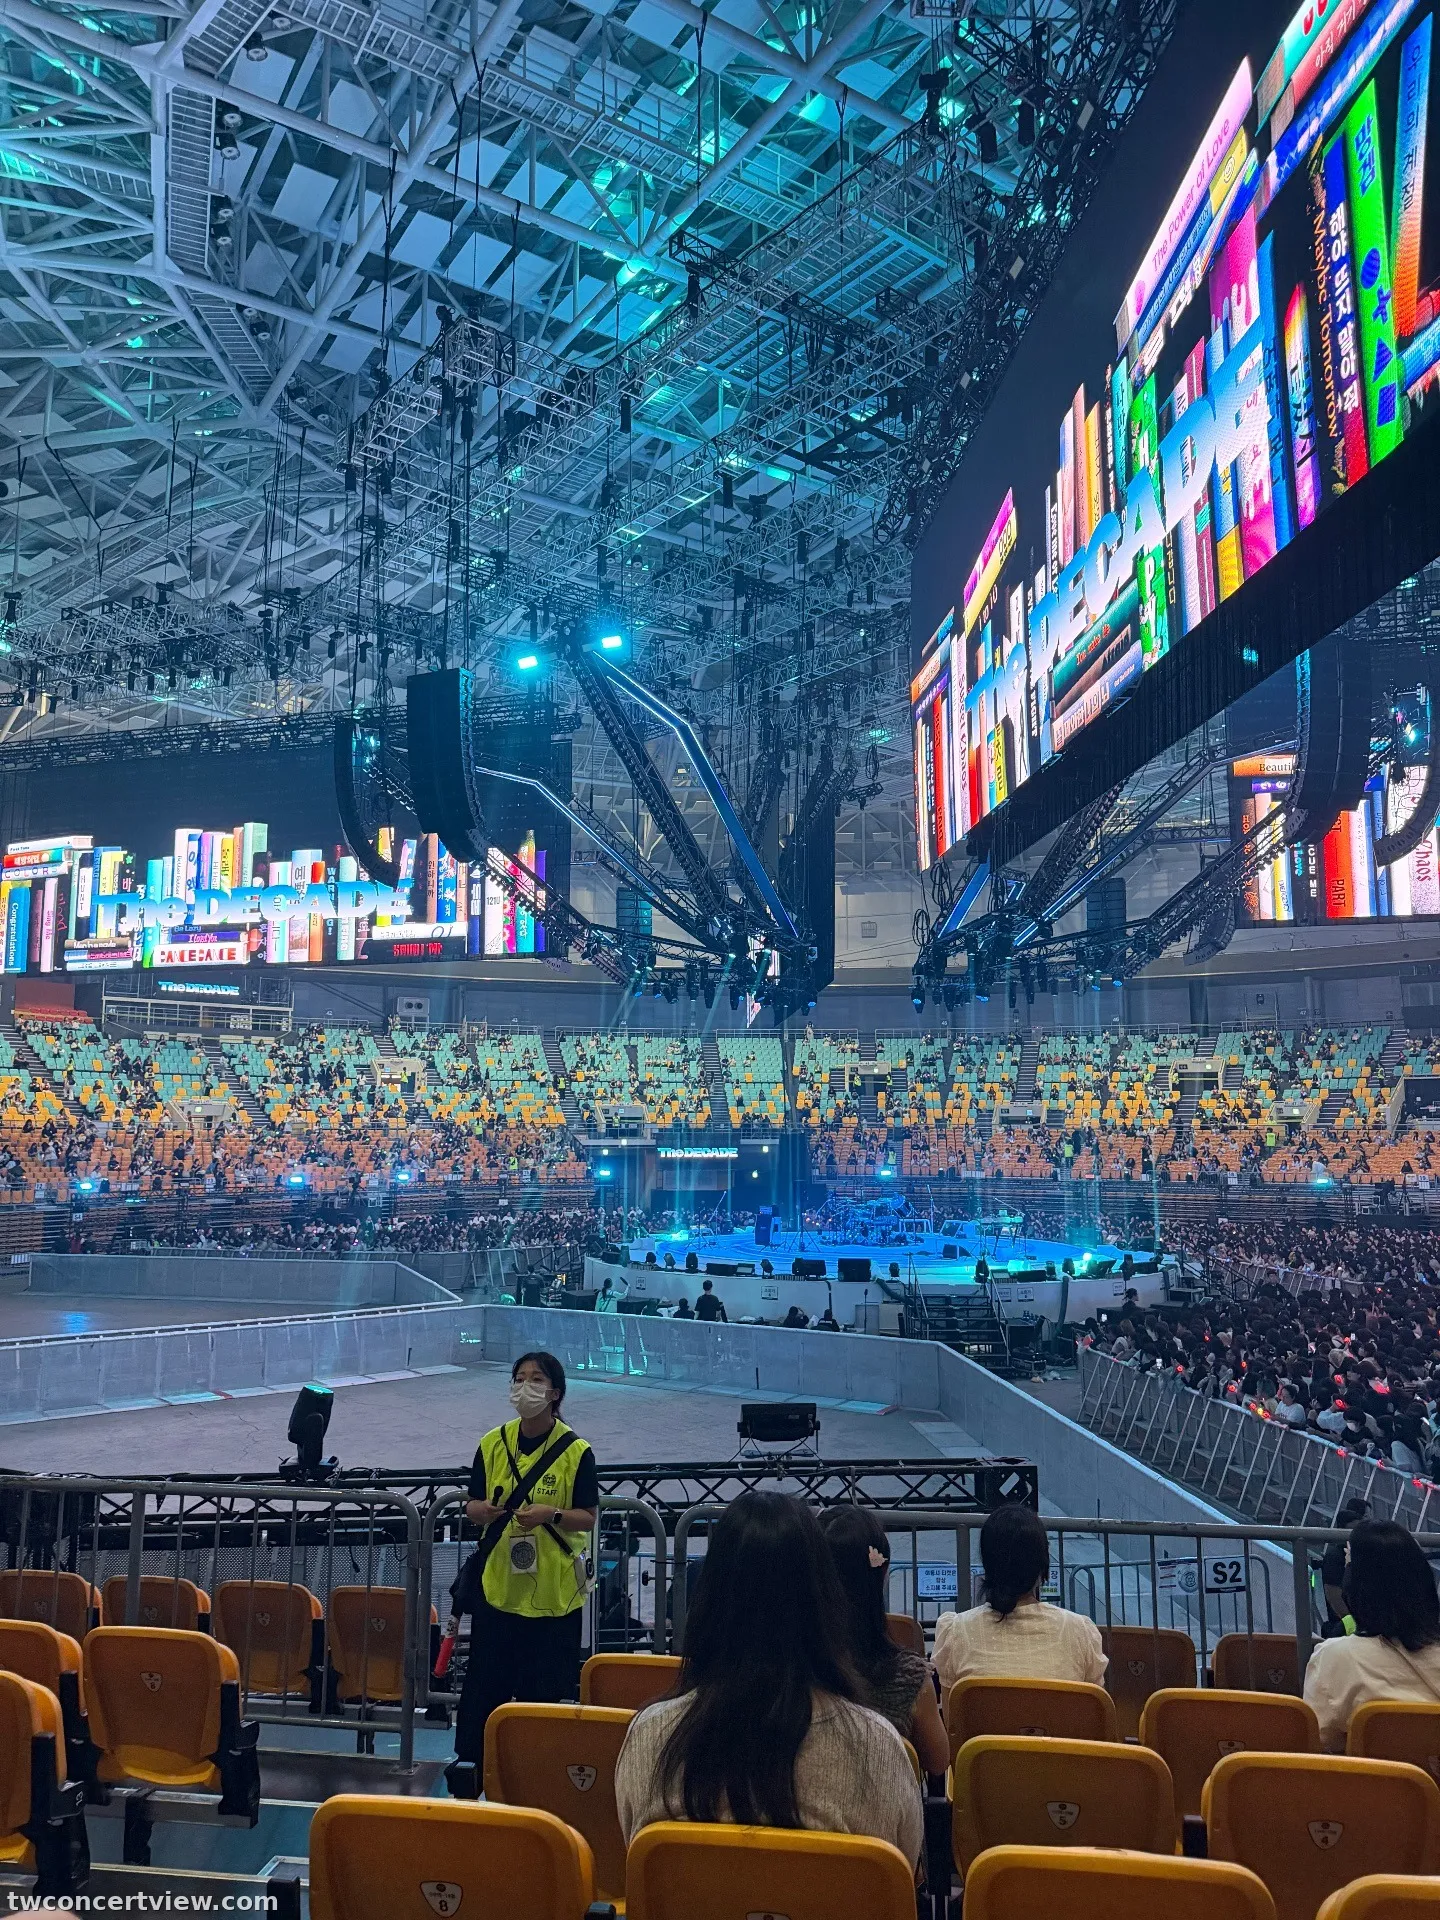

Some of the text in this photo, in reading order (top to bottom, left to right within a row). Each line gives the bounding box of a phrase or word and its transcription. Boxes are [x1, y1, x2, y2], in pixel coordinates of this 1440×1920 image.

[1151, 245, 1168, 272] The
[1168, 191, 1195, 240] Power
[1205, 117, 1231, 163] Love
[1313, 210, 1338, 438] Maybe Tomorrow
[1331, 879, 1346, 908] PART
[91, 893, 188, 931] The
[192, 880, 412, 924] DECADE
[9, 902, 19, 967] Congratulations
[160, 981, 240, 996] The DECADE
[657, 1147, 739, 1158] The DECADE
[536, 1487, 558, 1497] STAFF
[1213, 1561, 1243, 1584] S2
[579, 1778, 587, 1788] 7
[1058, 1816, 1067, 1826] 5
[438, 1899, 449, 1913] 8
